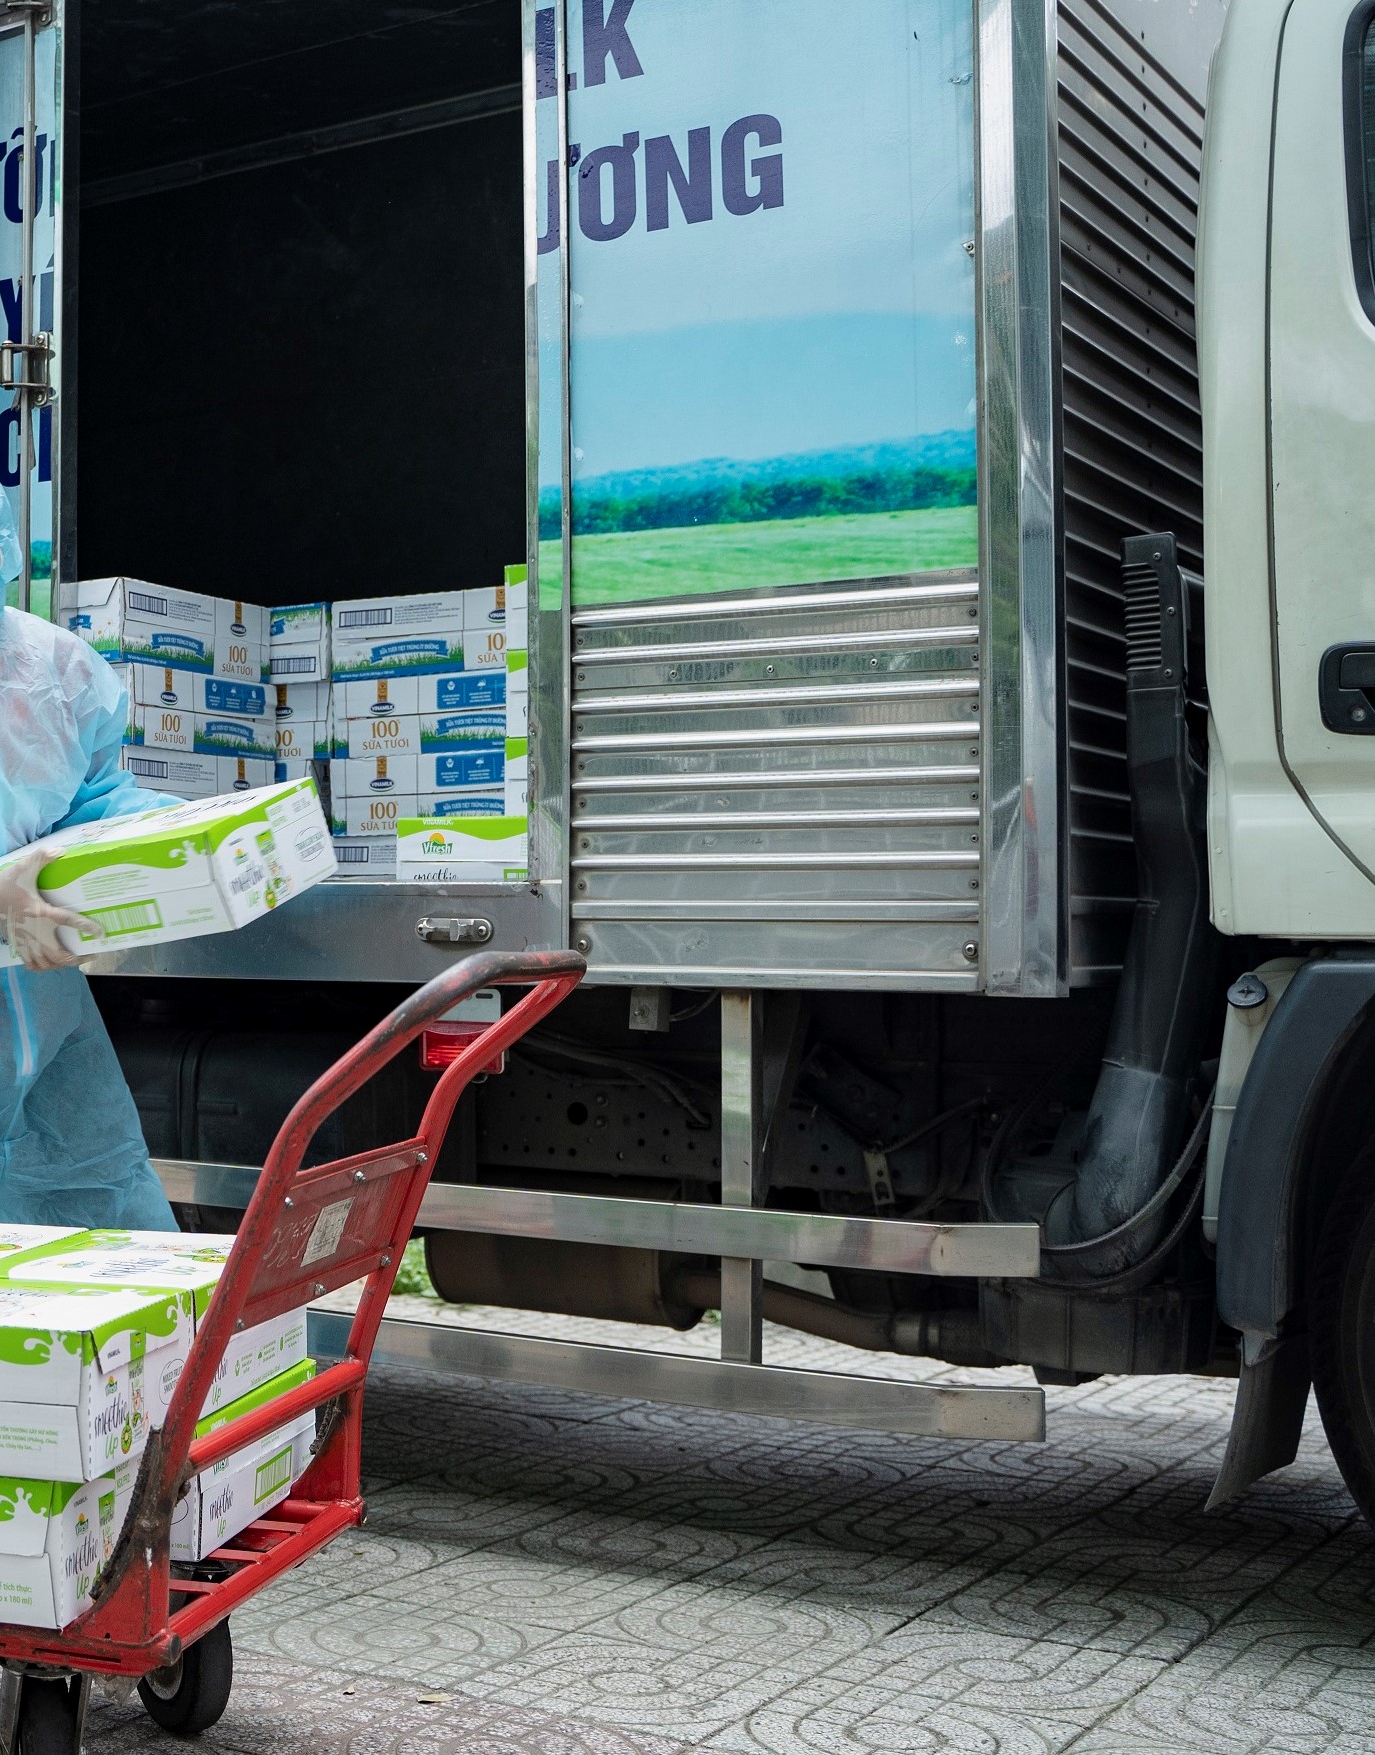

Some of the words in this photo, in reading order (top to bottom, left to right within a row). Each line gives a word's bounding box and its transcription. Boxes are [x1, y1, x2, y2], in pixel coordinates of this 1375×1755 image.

[477, 653, 498, 664] SỮA
[222, 663, 236, 673] SỮA
[236, 665, 253, 676] TƯƠI
[371, 704, 394, 712] VINAMILK
[154, 731, 168, 742] SỮA
[169, 733, 187, 744] TƯƠI
[362, 739, 381, 751] SỮA
[383, 738, 409, 749] TƯƠI
[278, 747, 301, 757] TƯƠI
[371, 780, 394, 788] VINAMILK
[360, 820, 380, 832] SỮA
[422, 841, 453, 855] Vfresh
[10, 1594, 20, 1603] 180
